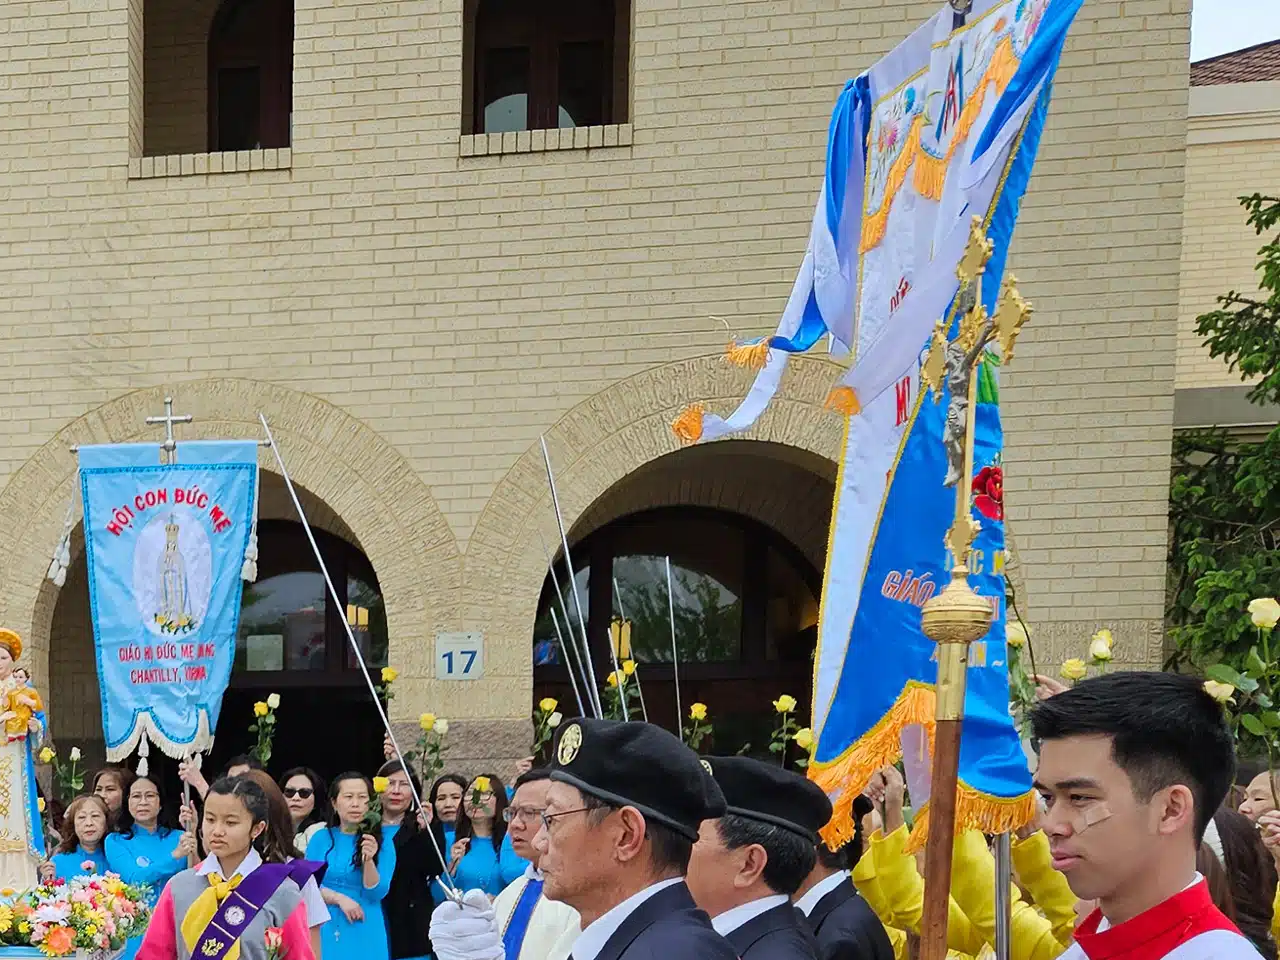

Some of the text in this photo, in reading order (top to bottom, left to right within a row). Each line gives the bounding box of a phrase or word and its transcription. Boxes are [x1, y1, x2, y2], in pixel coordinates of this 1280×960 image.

[106, 504, 135, 536] HỘI
[134, 488, 167, 511] CON
[174, 484, 209, 509] ĐỨC
[119, 643, 141, 662] GIÁO
[441, 650, 478, 674] 17
